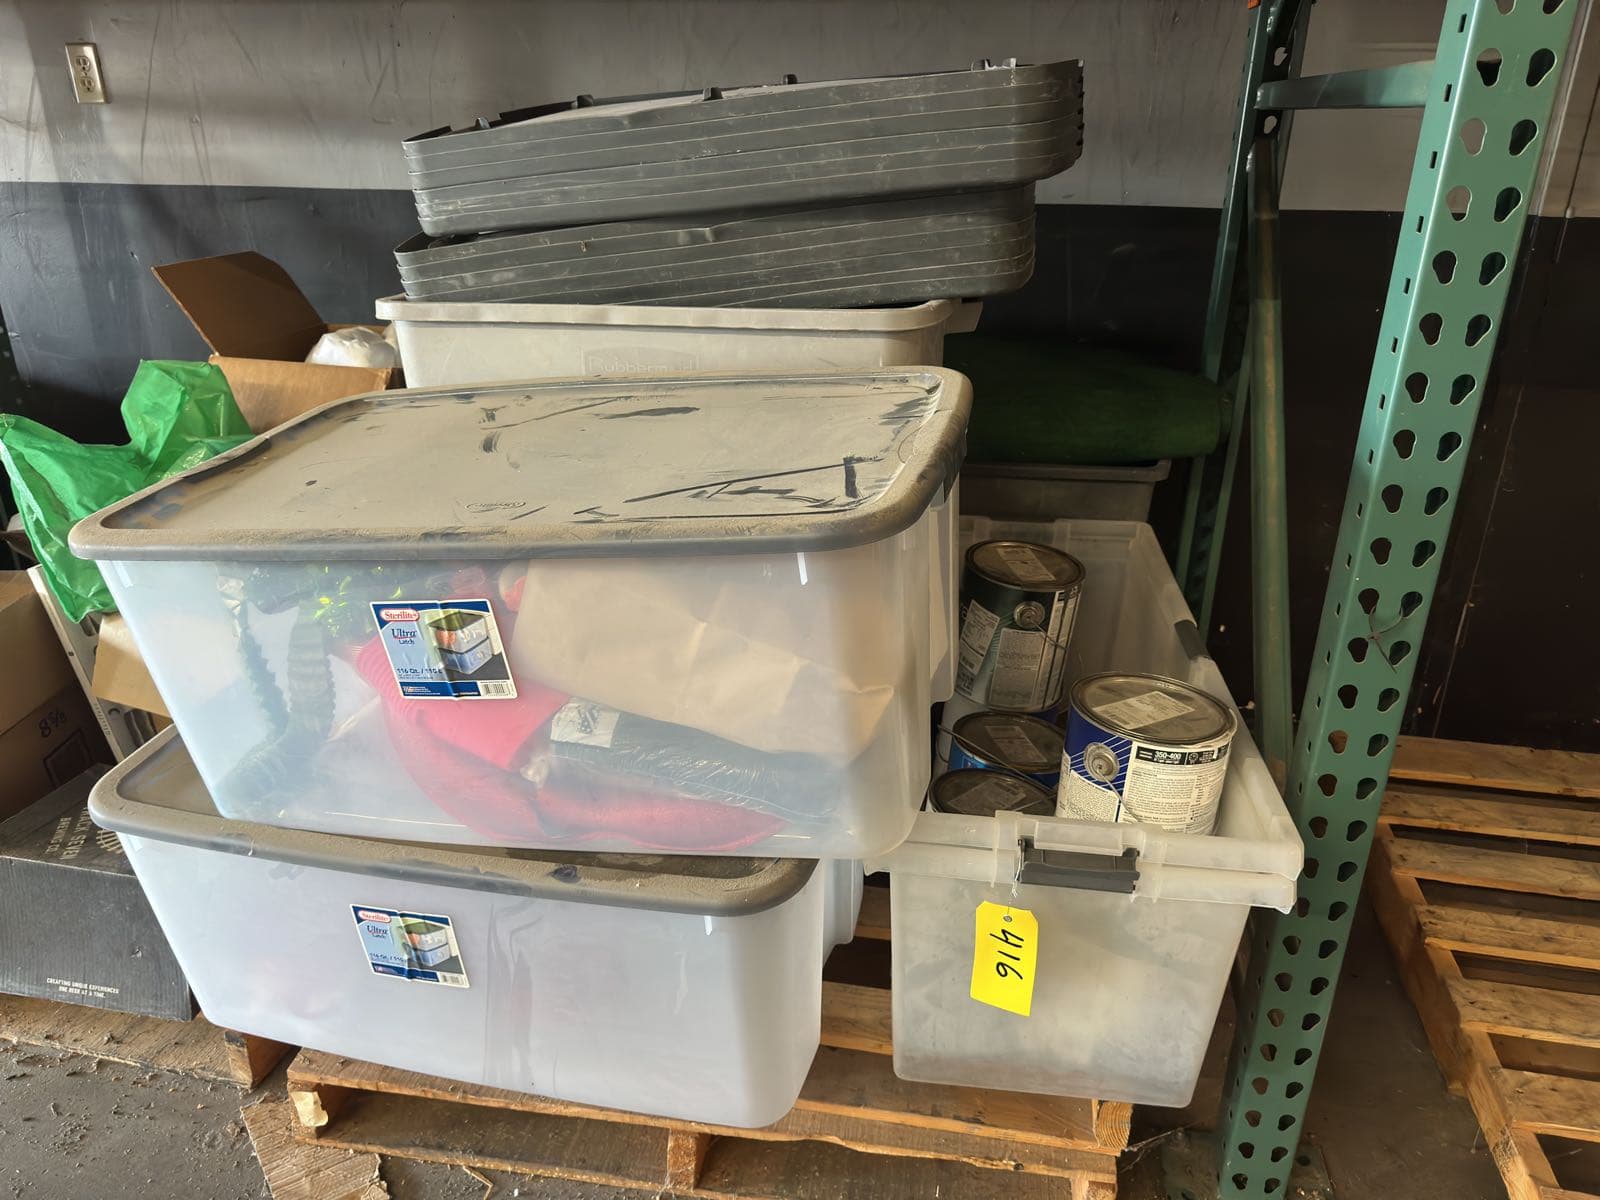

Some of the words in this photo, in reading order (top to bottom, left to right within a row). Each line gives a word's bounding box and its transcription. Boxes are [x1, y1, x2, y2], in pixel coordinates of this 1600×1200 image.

[383, 610, 418, 620] Sterilite
[391, 628, 417, 638] Ultra
[1154, 751, 1182, 760] 350-400
[367, 925, 388, 935] Ultra
[989, 928, 1025, 980] 416
